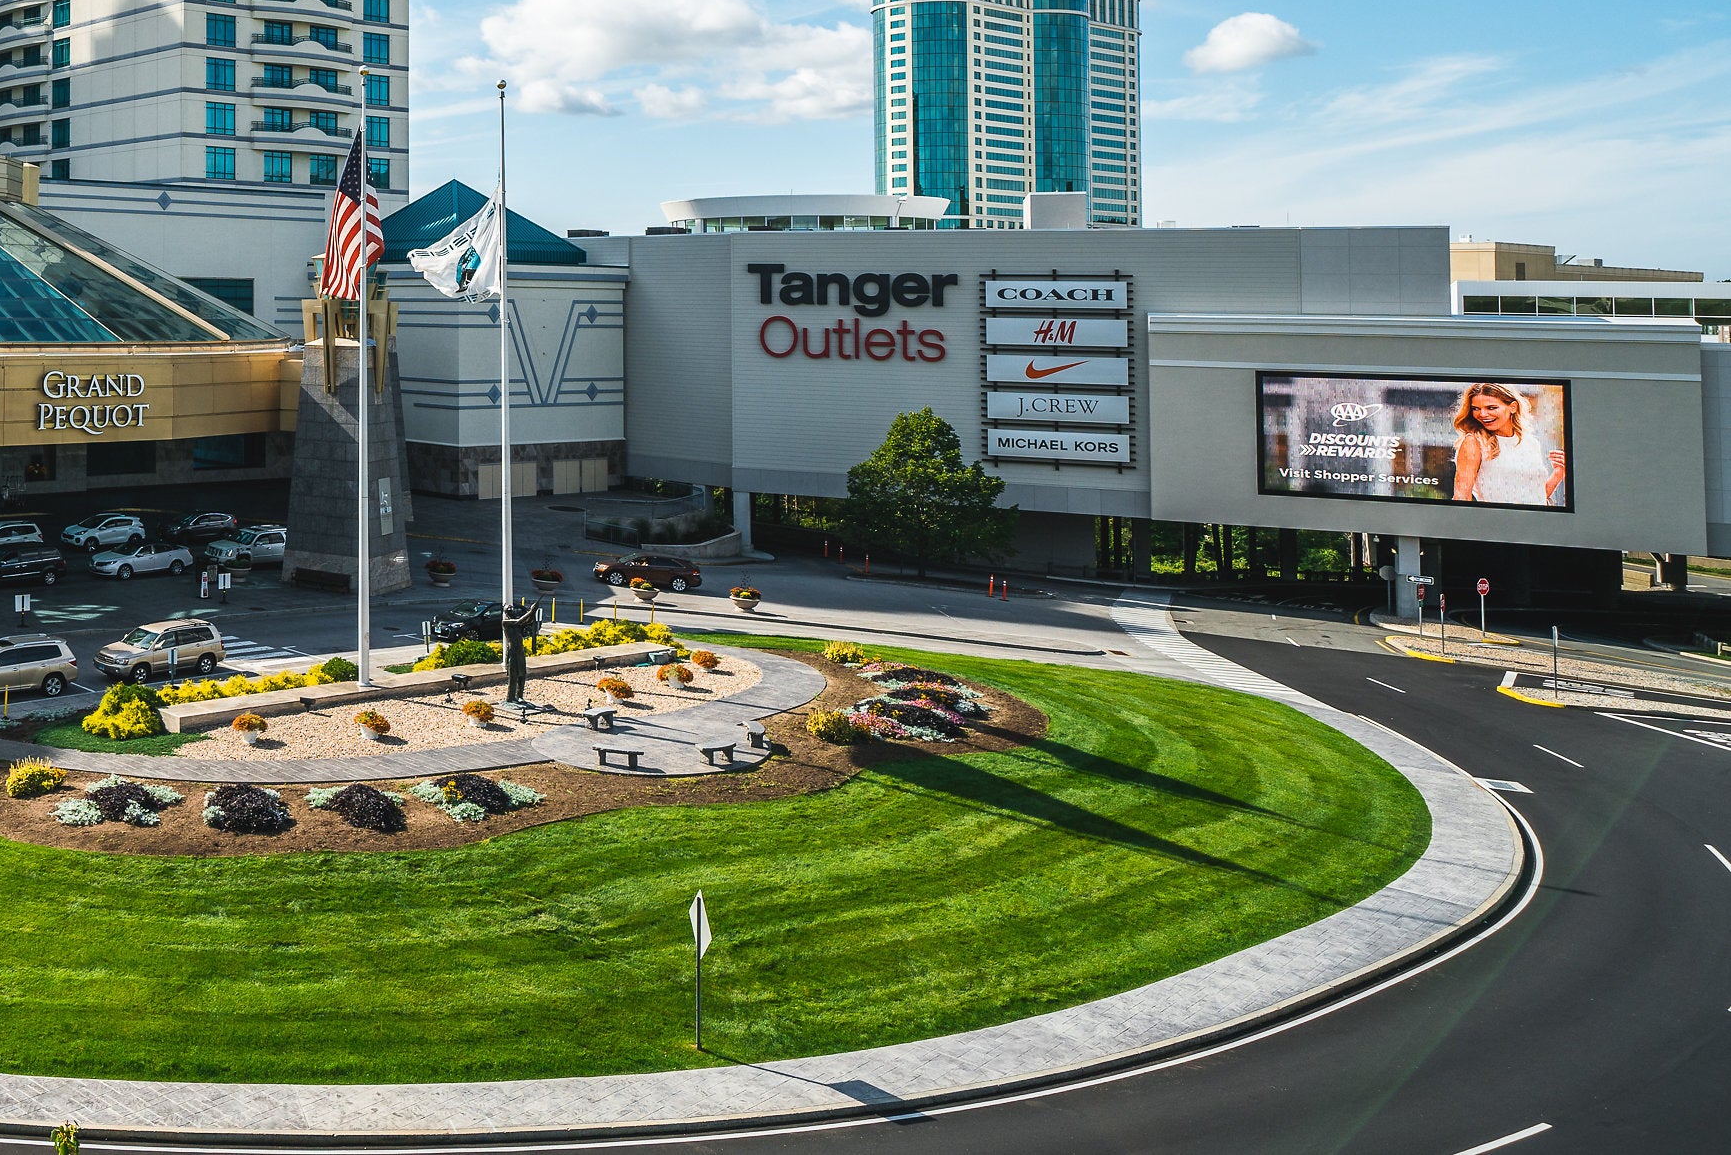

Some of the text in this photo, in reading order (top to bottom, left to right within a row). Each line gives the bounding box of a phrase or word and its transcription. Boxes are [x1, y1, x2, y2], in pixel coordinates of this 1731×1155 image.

[747, 263, 958, 317] Tanger
[997, 287, 1114, 301] COACH
[759, 315, 946, 362] Outlets
[1033, 319, 1077, 344] H&M
[42, 370, 145, 399] GRAND
[1017, 397, 1099, 417] J.CREW
[37, 403, 150, 435] PEQUOT
[997, 437, 1119, 453] MICHAEL KORS
[1308, 432, 1400, 448] DISCOUNTS
[1316, 445, 1397, 460] REWARDS
[1279, 468, 1439, 485] Visit Shopper Services
